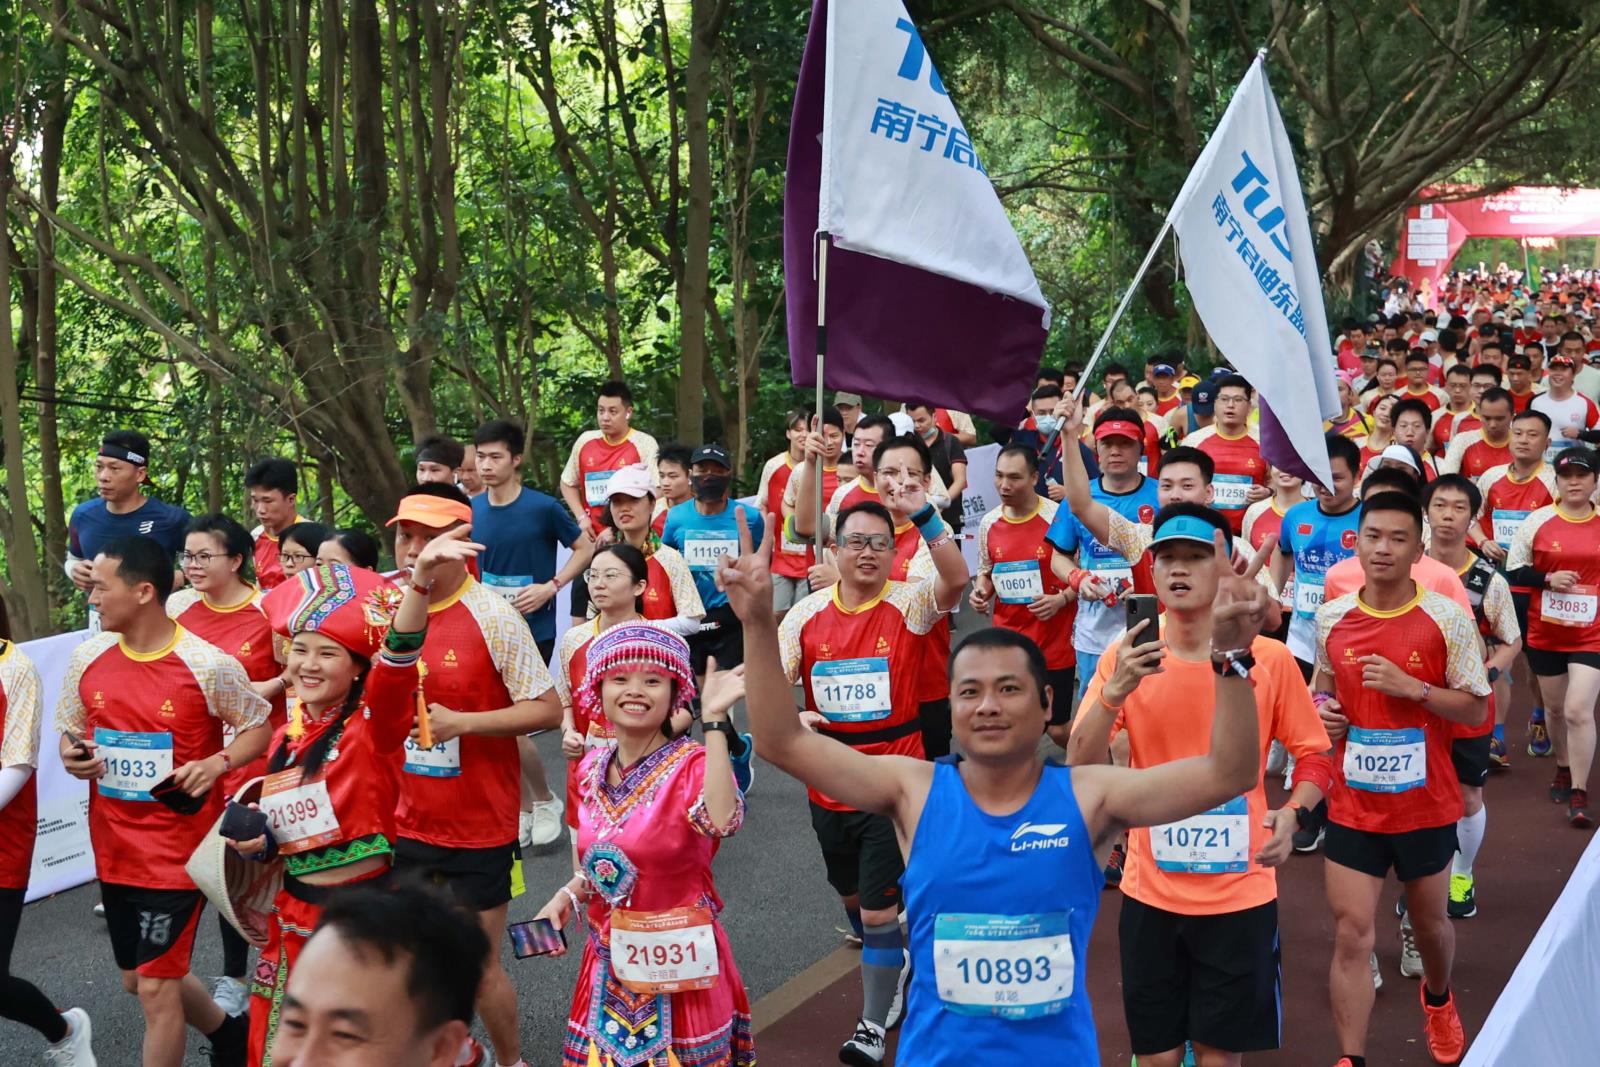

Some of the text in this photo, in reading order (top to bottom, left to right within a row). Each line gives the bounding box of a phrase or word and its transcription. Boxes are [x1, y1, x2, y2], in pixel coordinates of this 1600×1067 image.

[870, 97, 989, 178] 南宁启
[1215, 488, 1245, 498] 11258
[1000, 577, 1032, 591] 10601
[1549, 599, 1588, 614] 23083
[824, 683, 876, 701] 11788
[103, 757, 156, 778] 11933
[1355, 754, 1413, 772] 10227
[269, 798, 318, 829] 21399
[1011, 836, 1069, 852] LI-NING
[1163, 827, 1229, 847] 10721
[626, 941, 697, 966] 21931
[957, 956, 1051, 985] 10893
